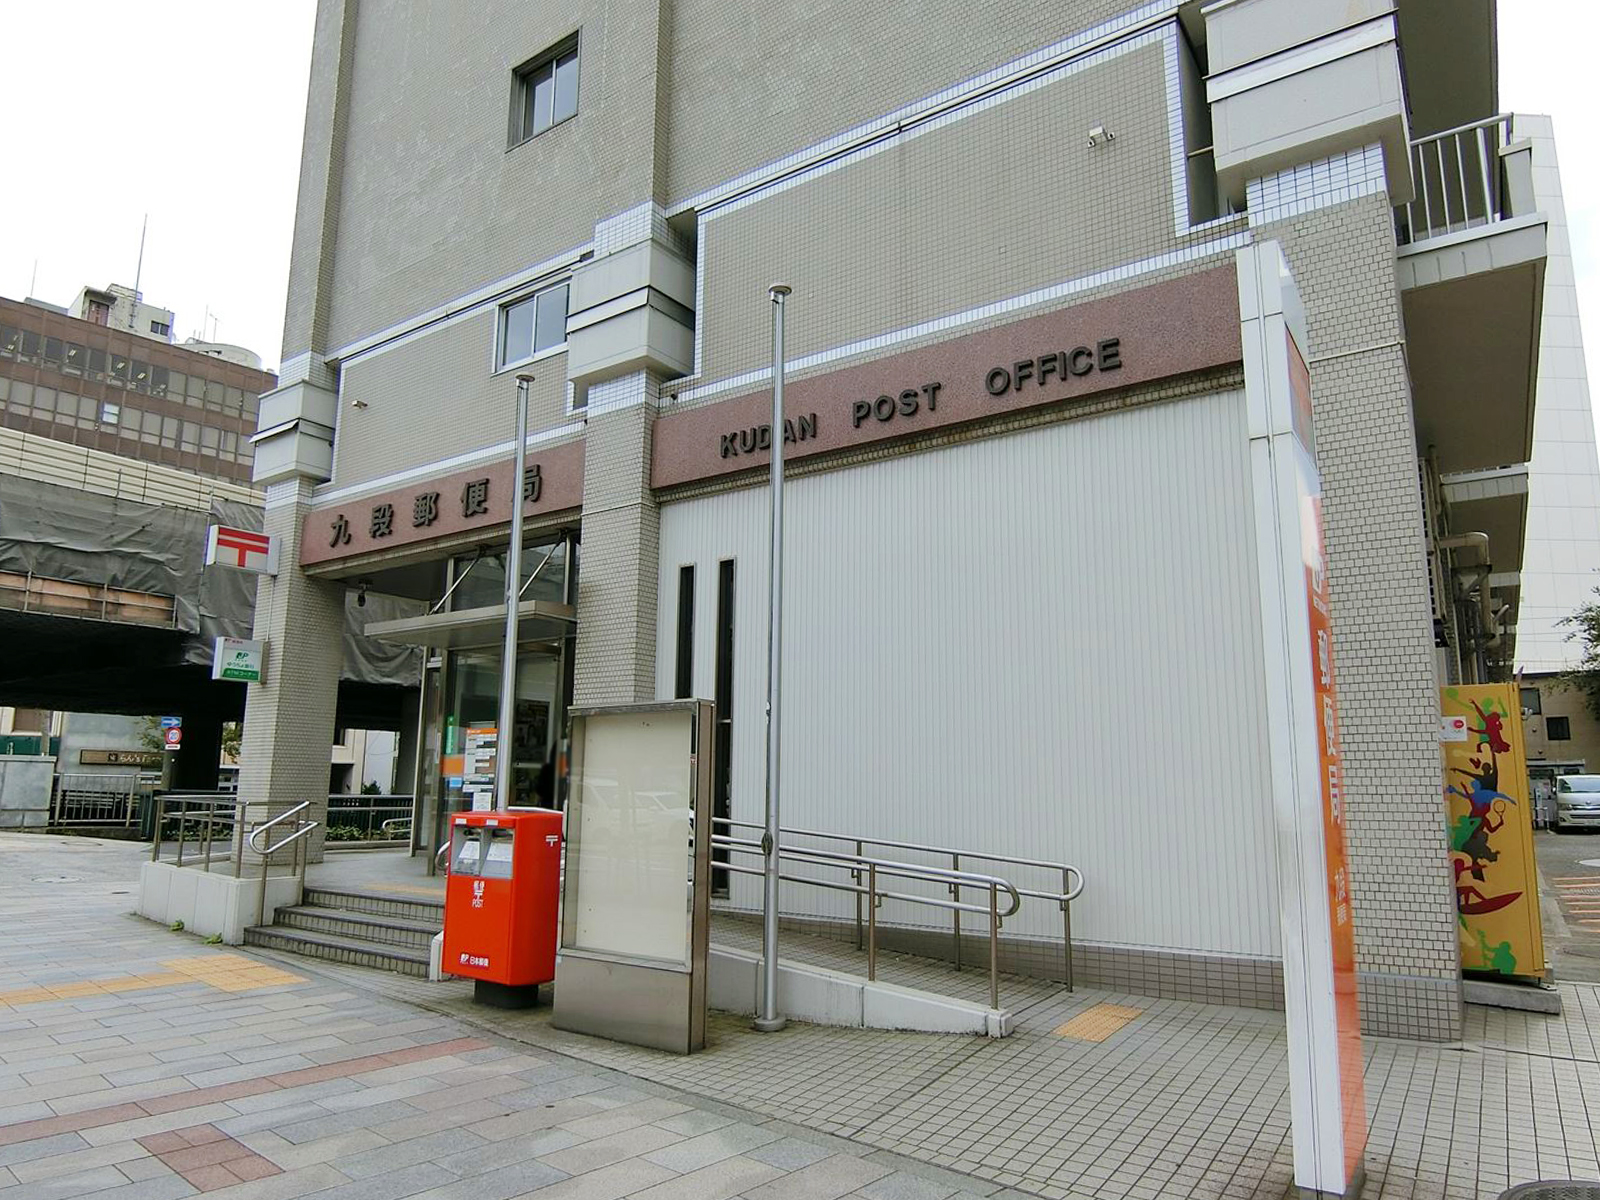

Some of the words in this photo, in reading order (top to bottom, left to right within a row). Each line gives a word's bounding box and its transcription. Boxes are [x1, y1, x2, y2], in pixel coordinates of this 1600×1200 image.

[720, 413, 817, 458] KUDAN
[852, 381, 942, 429] POST
[985, 337, 1121, 396] OFFICE
[329, 463, 542, 547] 九段郵便局
